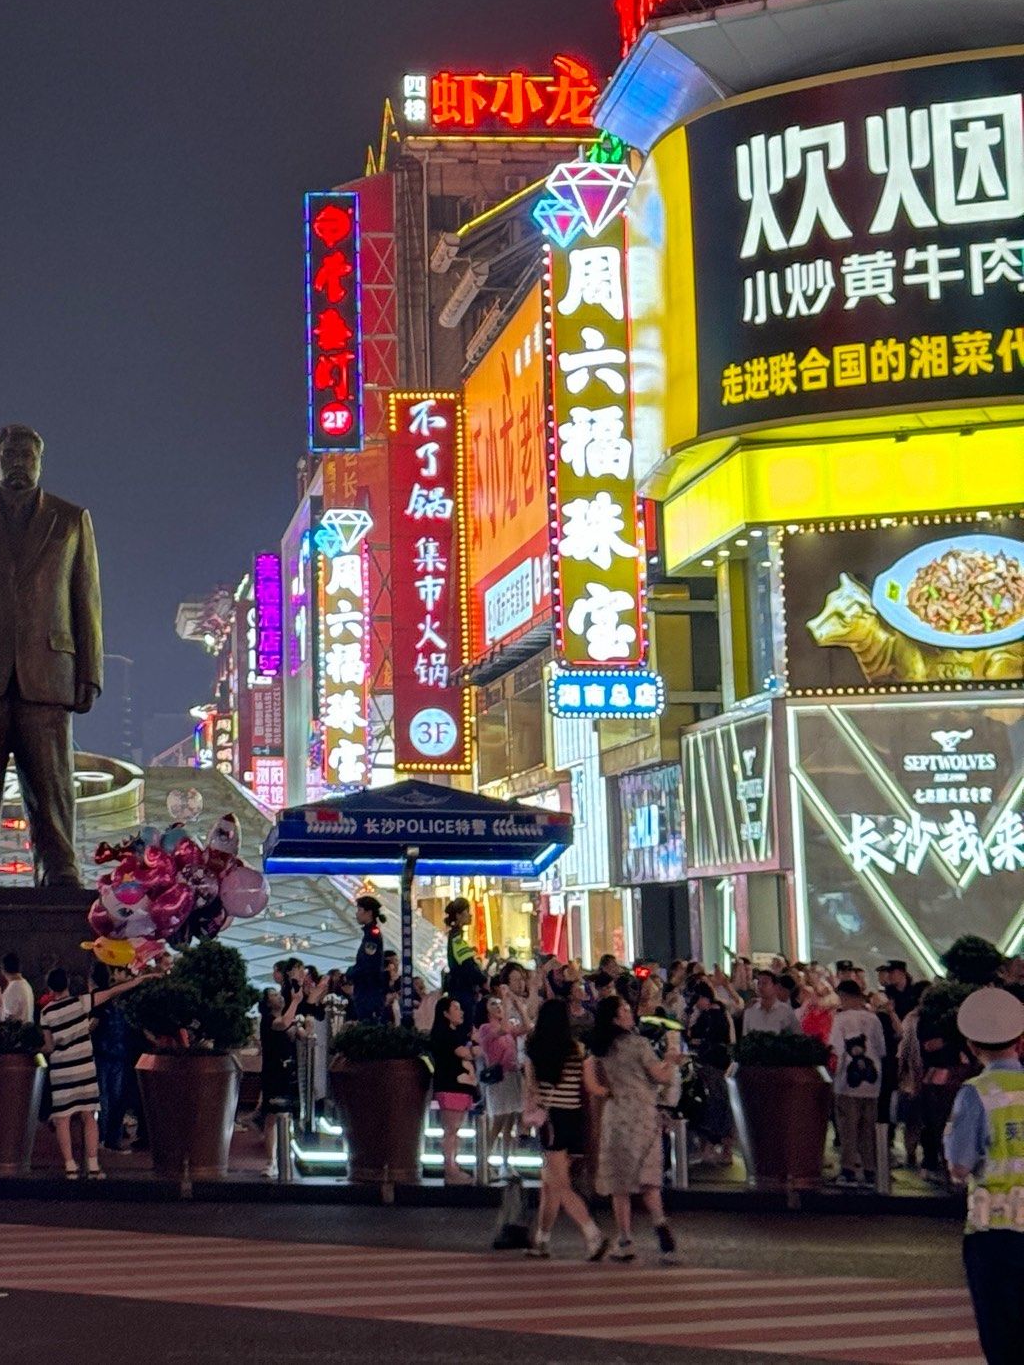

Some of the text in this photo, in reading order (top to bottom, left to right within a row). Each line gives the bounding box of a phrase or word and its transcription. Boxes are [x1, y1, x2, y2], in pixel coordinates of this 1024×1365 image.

[432, 54, 598, 125] 虾小龙
[735, 92, 1024, 260] 炊烟
[742, 237, 1024, 325] 小炒黄牛肉
[721, 327, 1024, 406] 走进联合国的湘菜代
[322, 411, 349, 428] 2F
[405, 402, 455, 520] 不了锅
[557, 246, 639, 662] 周六福珠宝
[412, 537, 450, 689] 集市火锅
[325, 554, 369, 783] 周六福珠宝
[417, 720, 451, 745] 3F
[903, 753, 997, 772] SEPTWOLVES
[363, 818, 487, 835] 长沙POLICE特警
